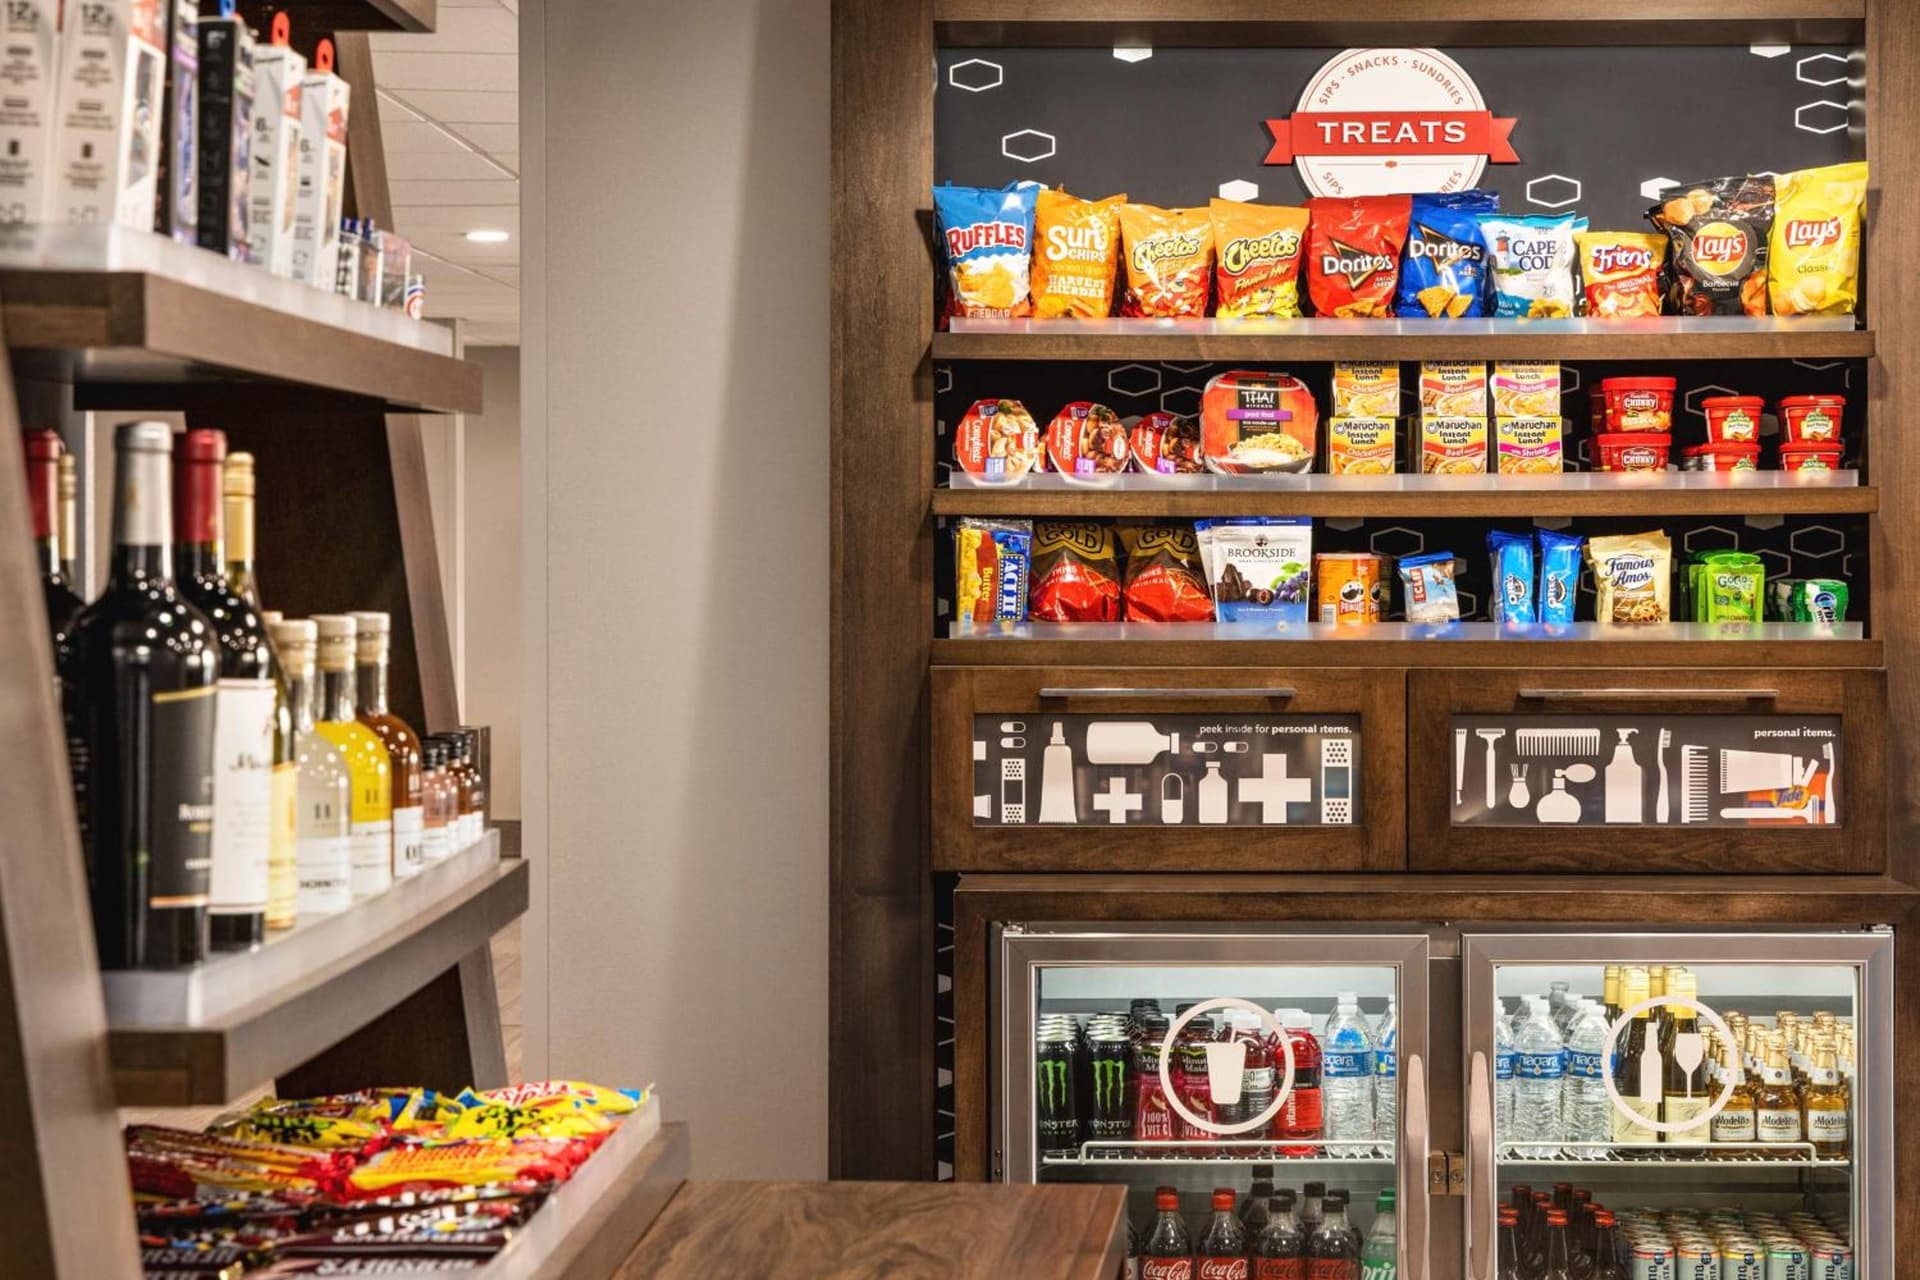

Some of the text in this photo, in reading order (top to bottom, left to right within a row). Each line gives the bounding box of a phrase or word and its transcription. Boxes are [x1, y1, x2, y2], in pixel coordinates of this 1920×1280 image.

[1319, 56, 1464, 105] SIPS SNACKS SUNDRIES
[1317, 121, 1467, 144] TREATS
[1322, 170, 1463, 195] SIPS RIES
[946, 222, 1025, 257] RUFFLES
[1789, 216, 1841, 248] Lay's
[1046, 225, 1108, 261] Sun
[1409, 238, 1481, 260] Doritos
[1512, 240, 1557, 256] CAPE
[1696, 234, 1743, 263] Lay's
[1068, 249, 1106, 263] CHIPS
[1132, 236, 1200, 272] Cheetos
[1224, 232, 1300, 275] Cheetos
[1519, 255, 1554, 271] COD
[1592, 245, 1653, 272] Fritos
[1323, 254, 1394, 275] Doritos
[1617, 275, 1653, 290] ORIGINAL
[1241, 390, 1275, 404] THAI
[1623, 398, 1656, 408] CHUNKY
[1344, 421, 1390, 430] Maruchan
[1436, 421, 1482, 430] Maruchan
[1511, 421, 1556, 430] Maruchan
[1623, 454, 1656, 465] CHUNKY
[1045, 528, 1098, 548] GOLD
[1142, 528, 1195, 549] GOLD
[1227, 548, 1296, 558] BROOKSIDE
[1604, 556, 1655, 577] Famous
[982, 567, 993, 603] Butter
[1003, 561, 1018, 593] ACT
[1611, 571, 1651, 587] Amos
[1200, 724, 1353, 735] peek inside for personal items.
[1754, 726, 1836, 739] personal items.
[1776, 788, 1803, 807] Tide
[1519, 1053, 1559, 1069] niagara
[1147, 1112, 1168, 1123] 100%
[1147, 1125, 1168, 1136] VIT C
[1143, 1259, 1191, 1280] Coca-Cola
[1201, 1259, 1249, 1280] Coca-Cola
